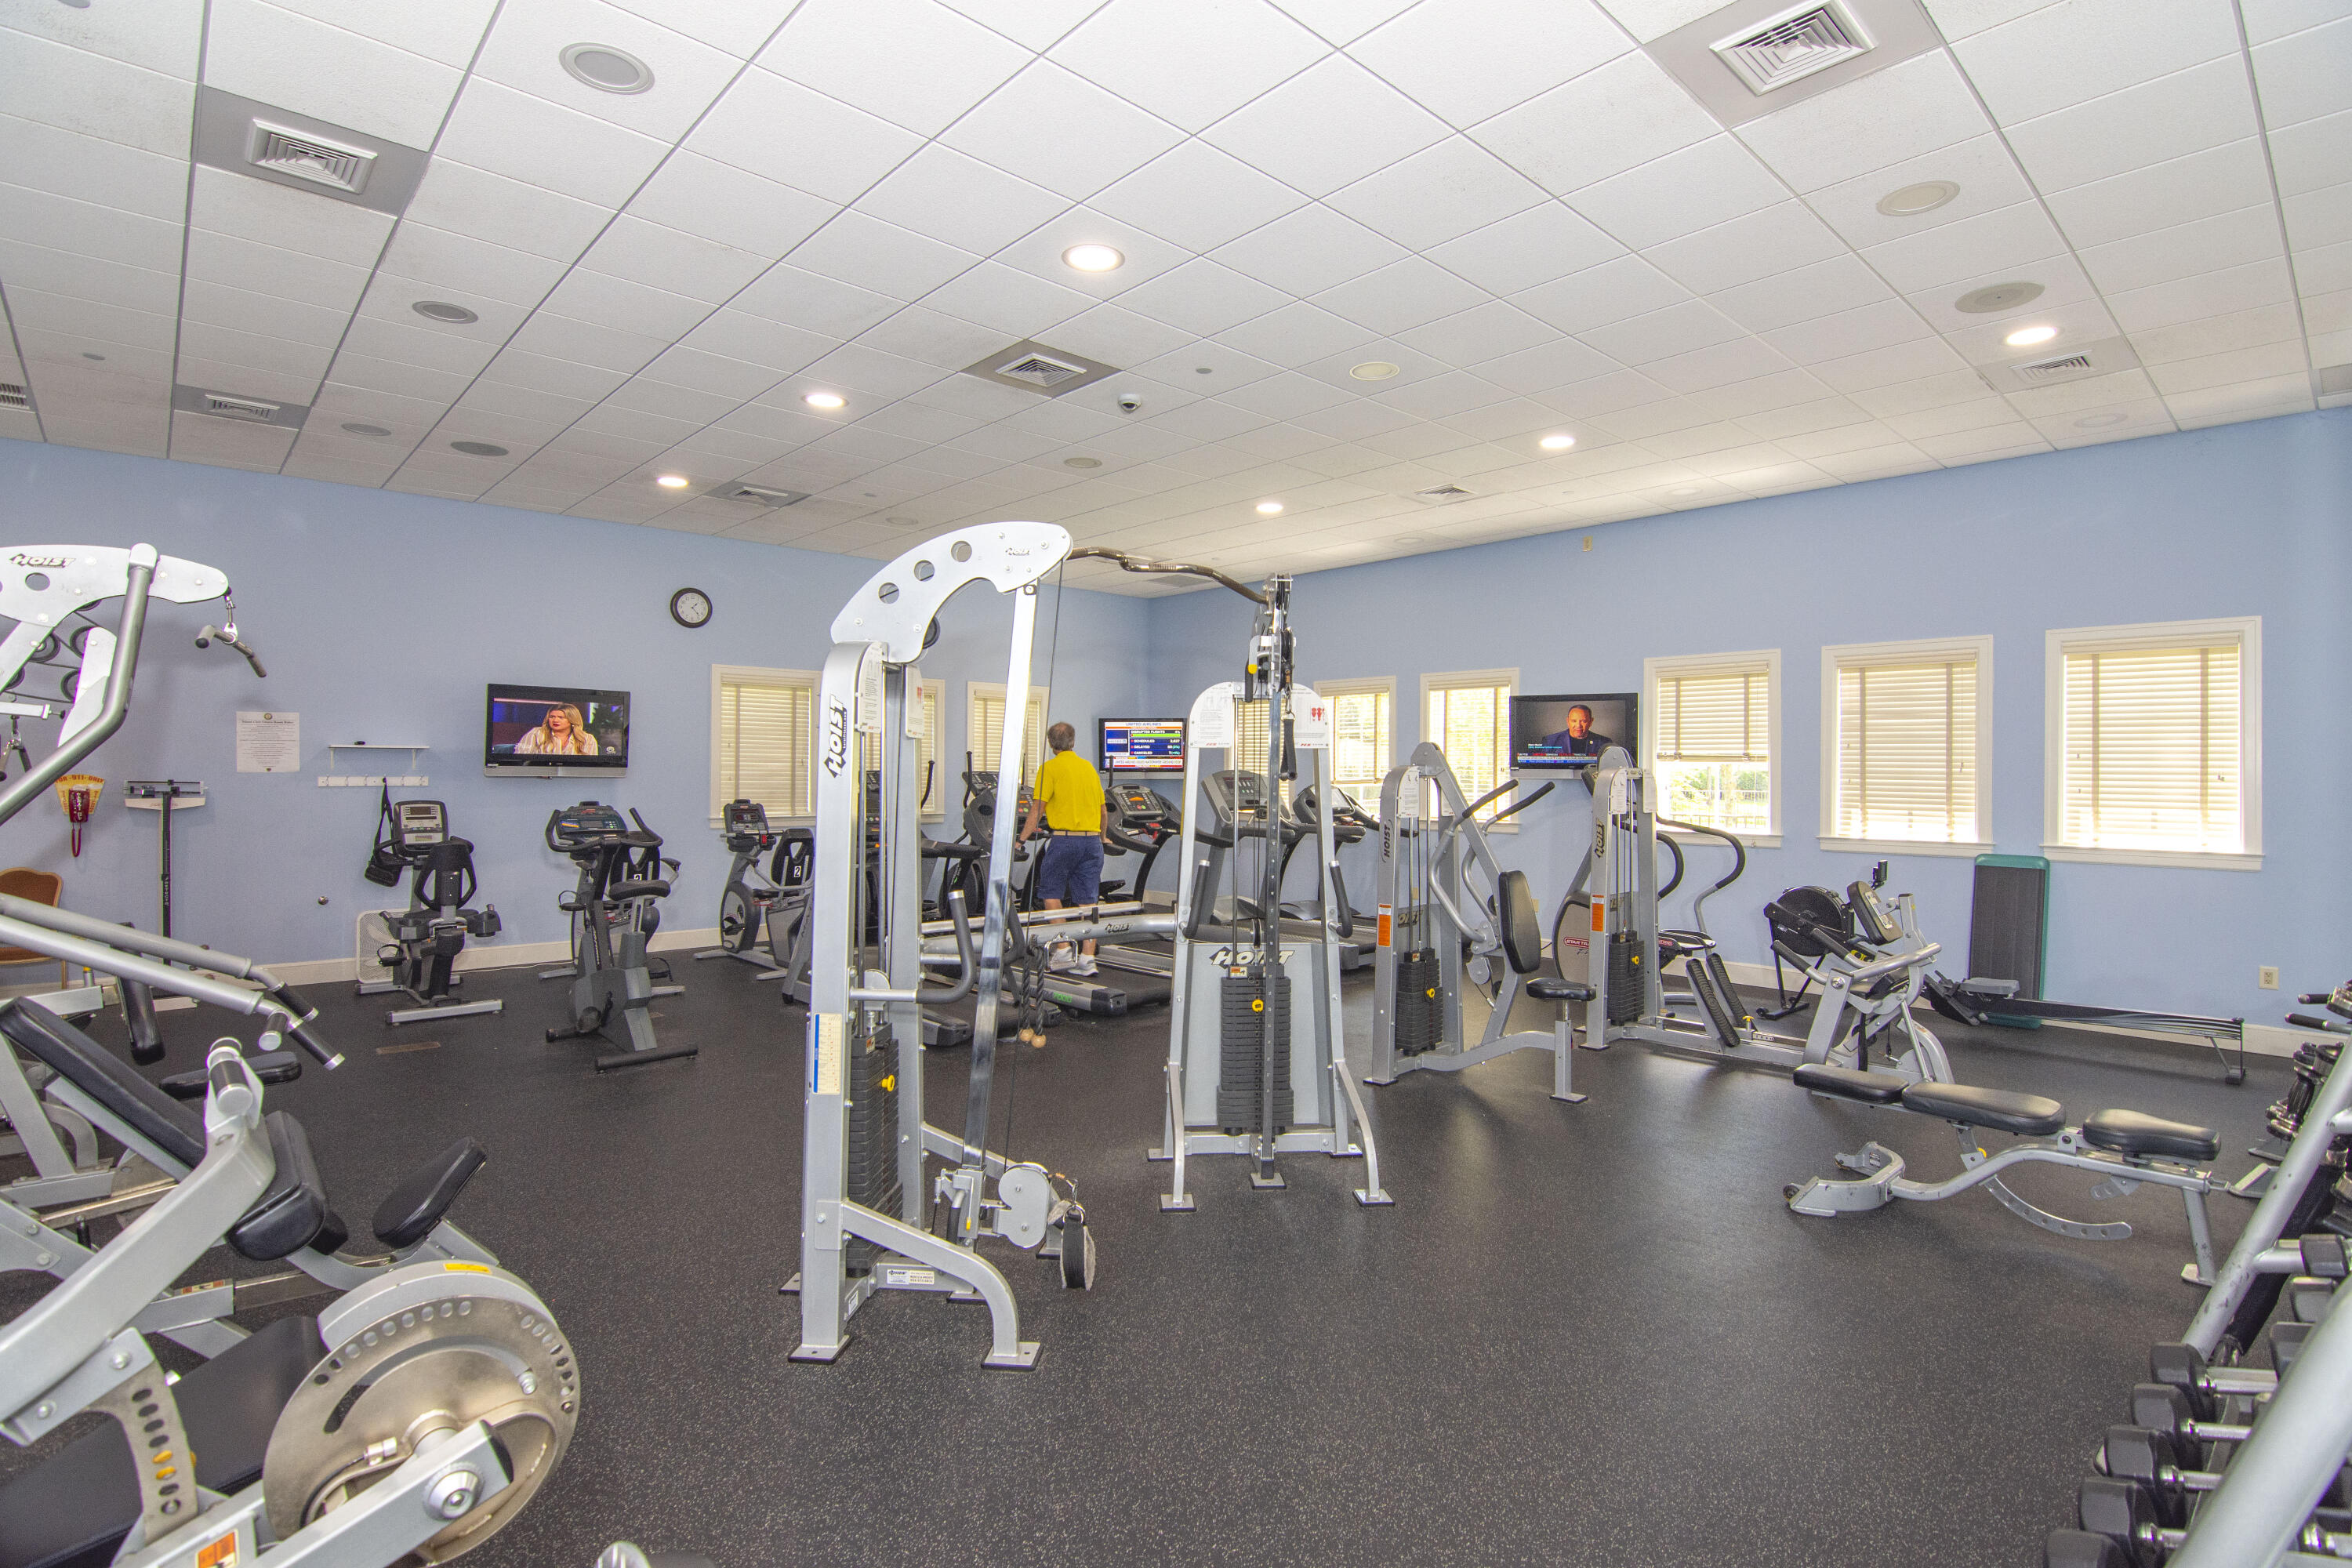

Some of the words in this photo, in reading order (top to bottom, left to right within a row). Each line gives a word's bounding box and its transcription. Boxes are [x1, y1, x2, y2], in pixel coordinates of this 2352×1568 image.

[10, 554, 76, 567] HOIST
[826, 694, 845, 777] HOIST
[1595, 818, 1605, 858] HOIST
[795, 866, 800, 877] 2
[1106, 922, 1134, 933] HOIST
[1211, 949, 1295, 966] HOIT
